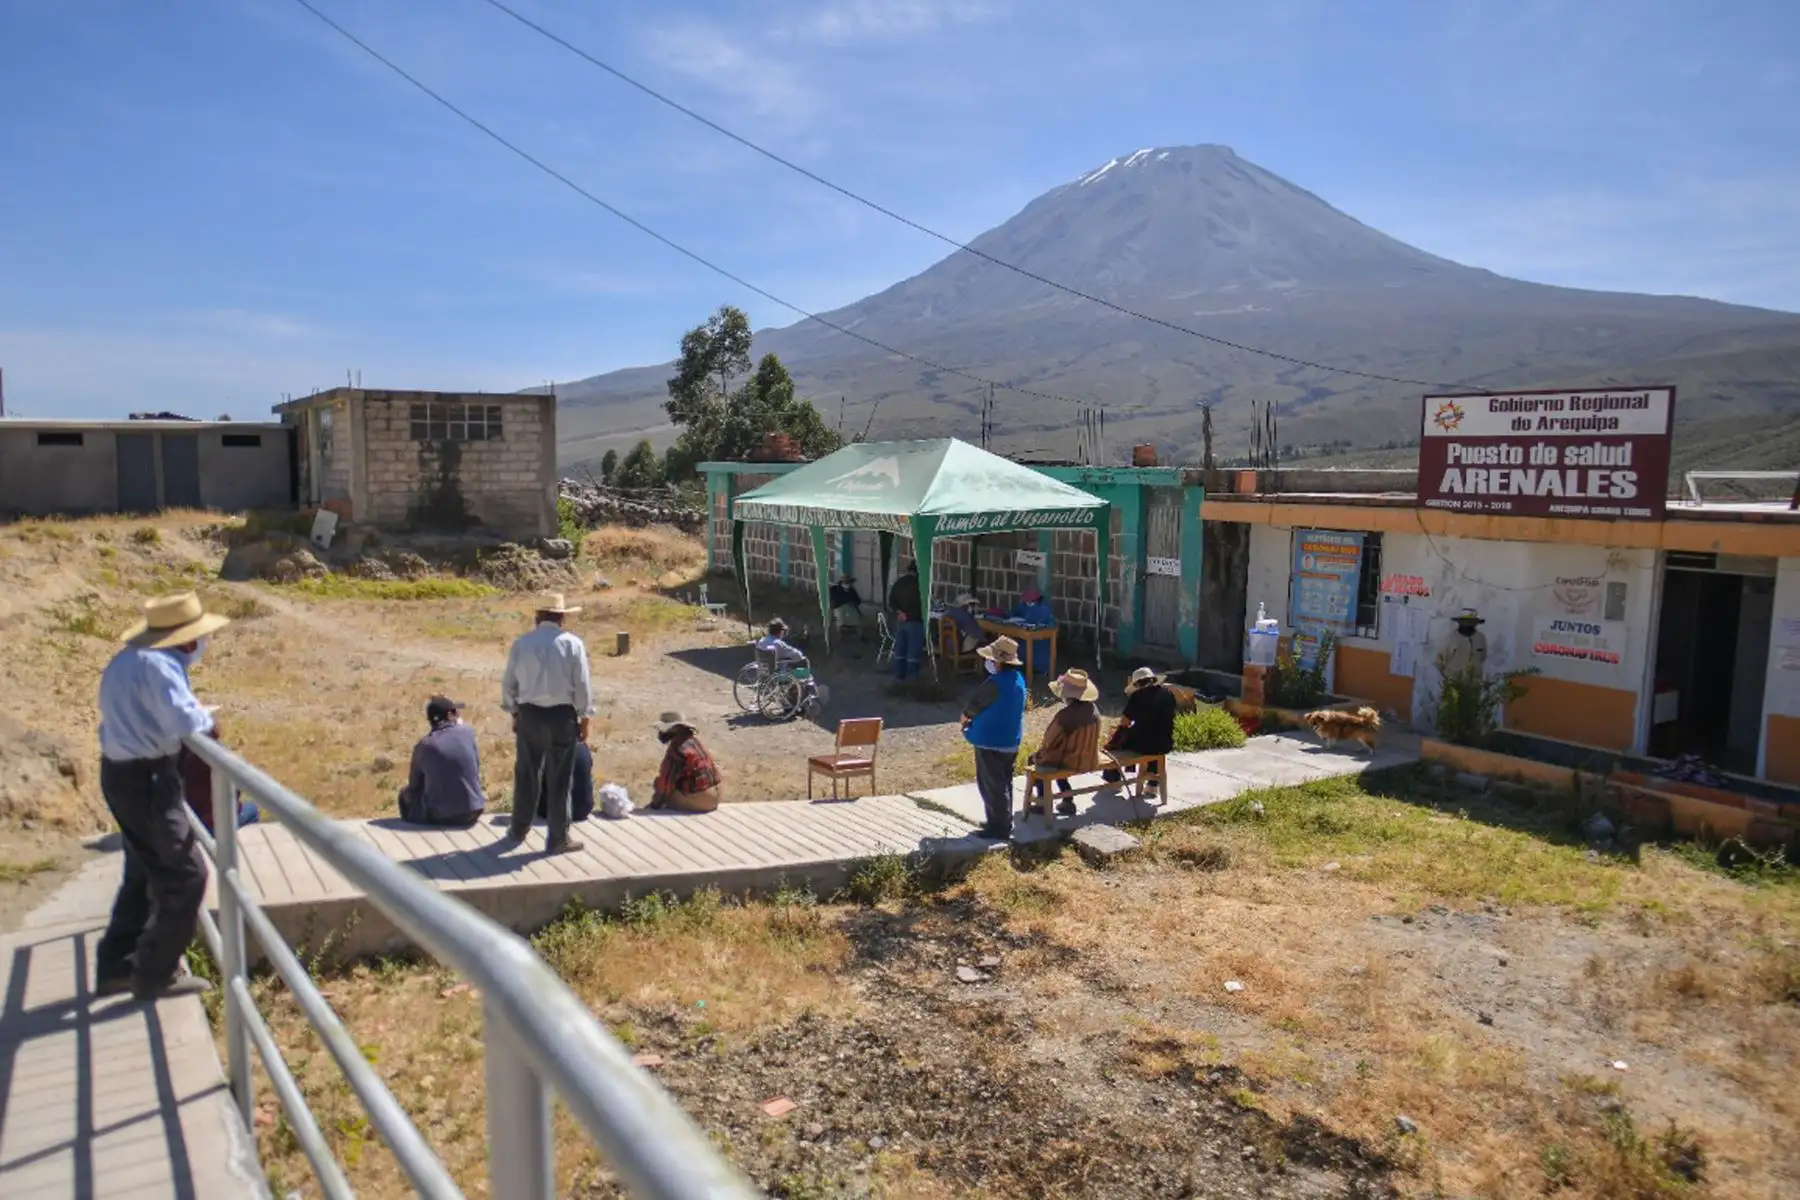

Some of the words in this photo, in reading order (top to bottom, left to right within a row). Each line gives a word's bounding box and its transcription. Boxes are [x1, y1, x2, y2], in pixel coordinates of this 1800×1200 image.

[1488, 397, 1564, 413] Gobierno
[1569, 393, 1649, 412] Regional
[1536, 414, 1619, 432] Arequipa
[1447, 442, 1523, 466] Puesto
[1529, 442, 1557, 465] de
[1563, 441, 1632, 466] salud
[1439, 468, 1638, 499] ARENALES
[935, 512, 987, 532] Rumbo
[990, 510, 1011, 528] al
[1011, 507, 1095, 527] Desarrollo
[1551, 620, 1601, 636] JUNTOS
